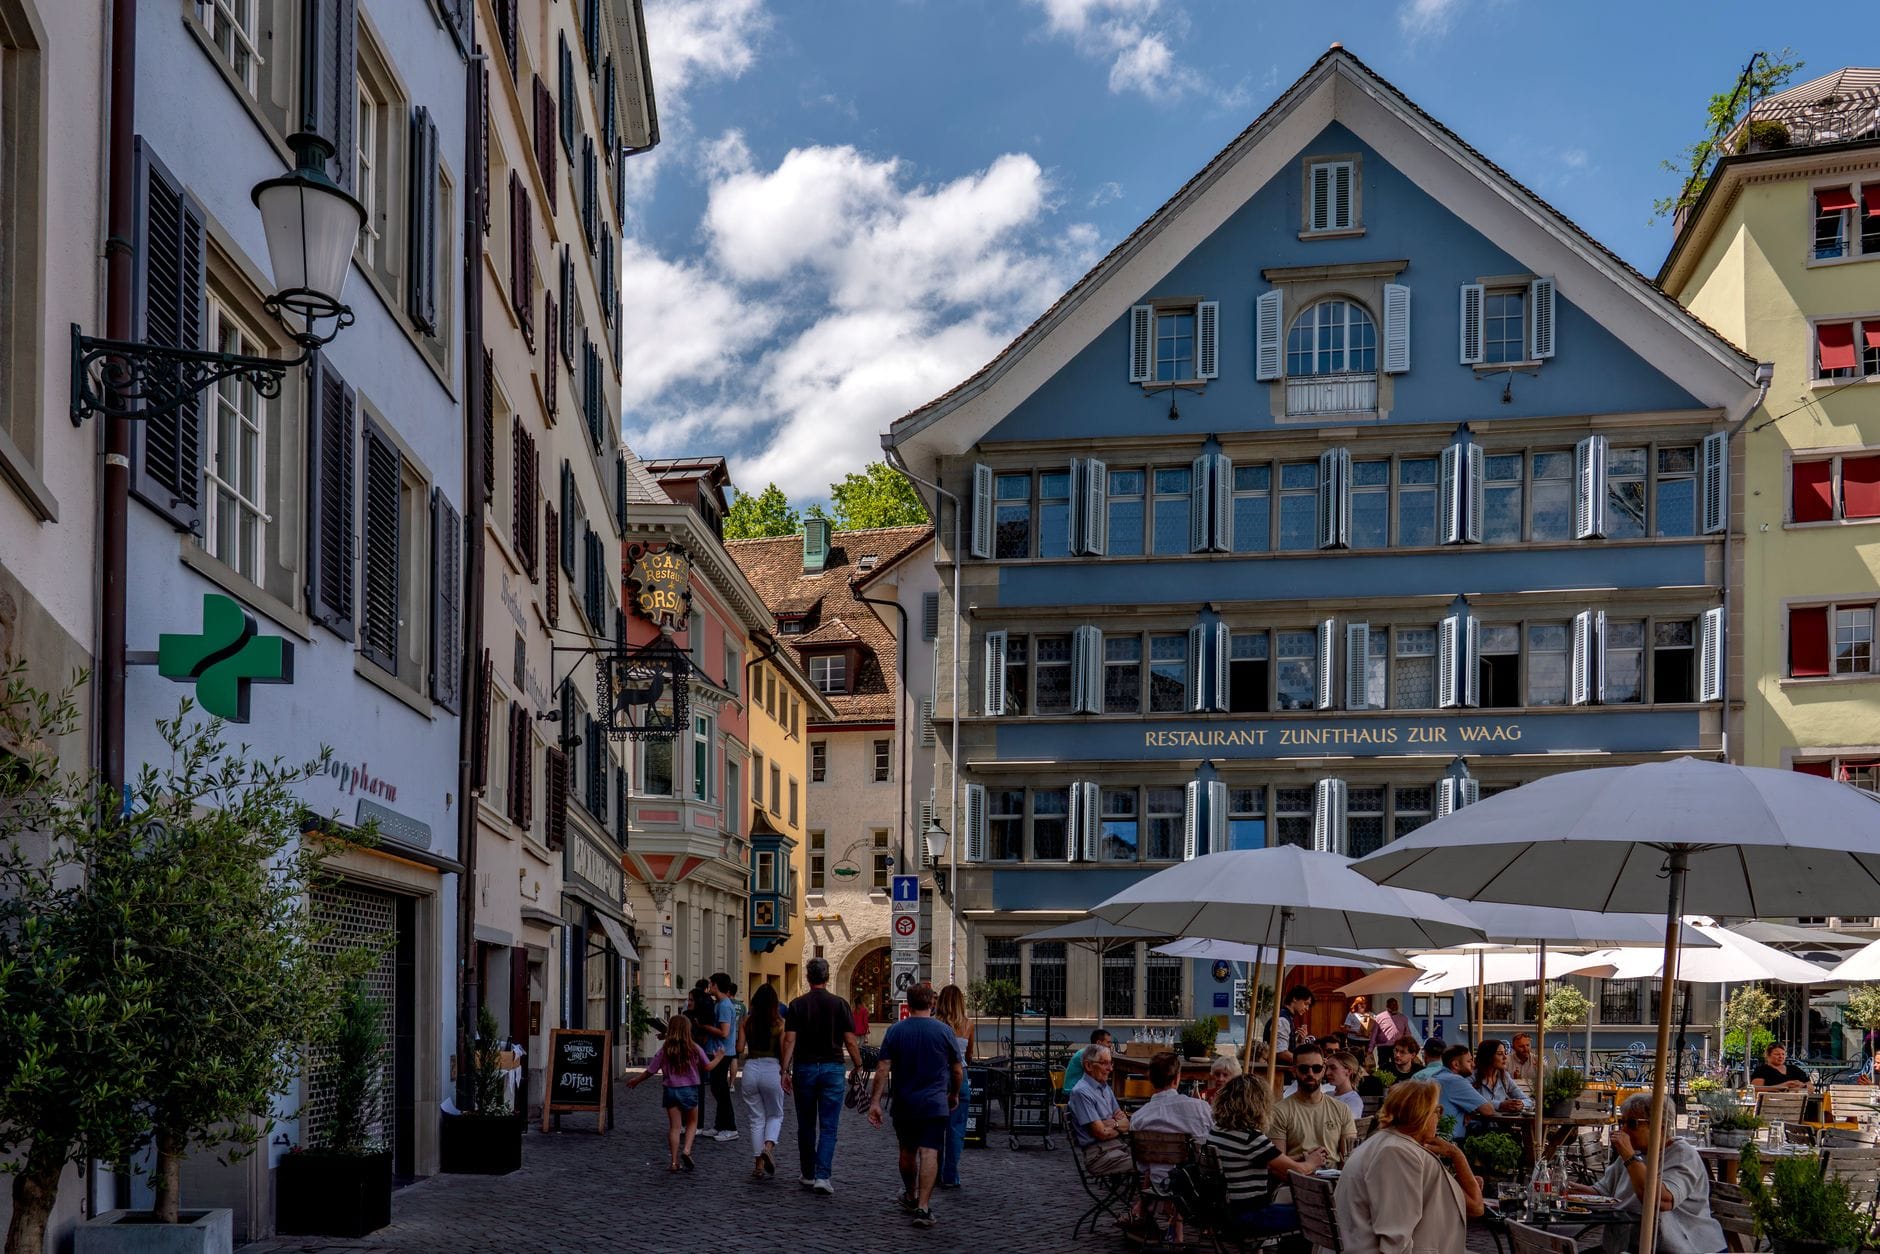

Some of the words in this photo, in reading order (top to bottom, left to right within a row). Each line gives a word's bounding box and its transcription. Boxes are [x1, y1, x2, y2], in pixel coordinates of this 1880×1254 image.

[1145, 730, 1269, 747] RESTAURANT
[1279, 727, 1398, 745] ZUNFTHAUS
[1407, 726, 1448, 743] ZUR
[1459, 725, 1522, 742] WAAG
